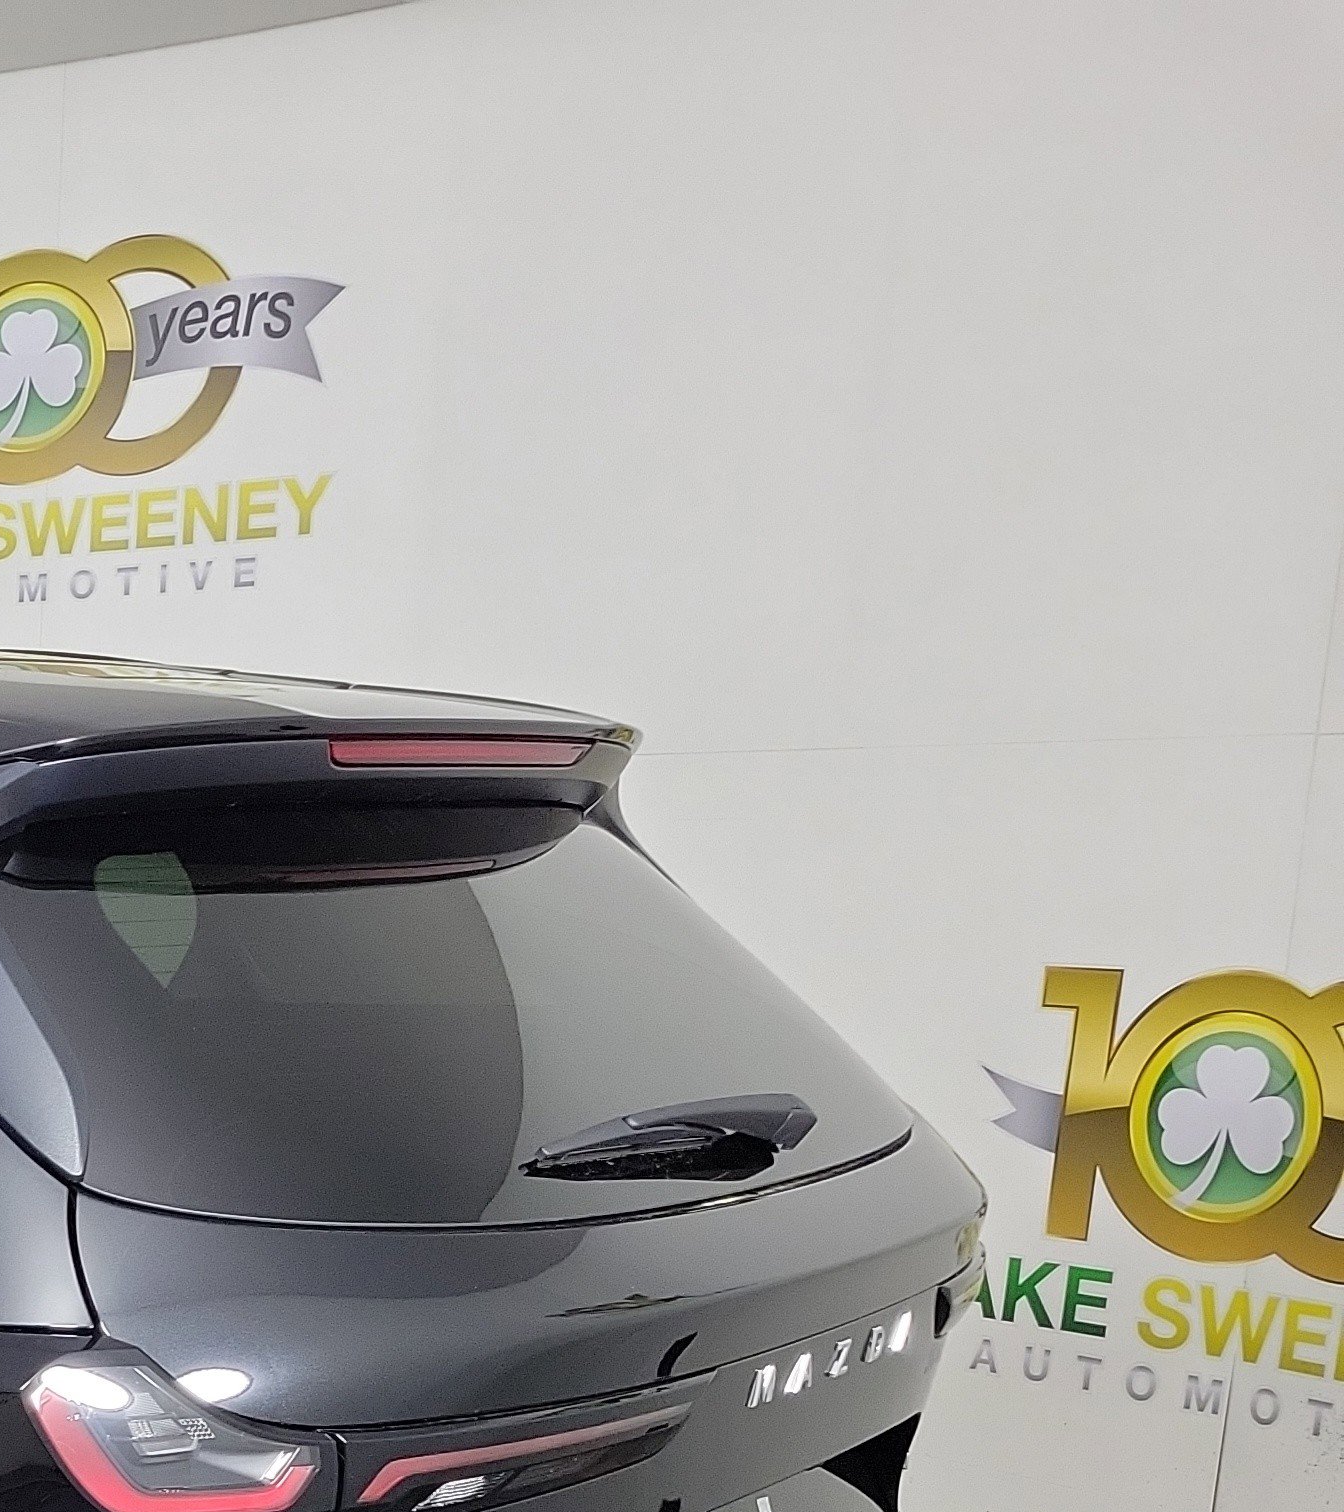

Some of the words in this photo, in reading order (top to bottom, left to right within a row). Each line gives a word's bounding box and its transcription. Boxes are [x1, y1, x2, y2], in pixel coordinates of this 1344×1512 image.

[145, 289, 295, 367] years
[745, 1311, 912, 1408] MAZDA
[972, 1257, 1115, 1339] AKE
[1137, 1276, 1344, 1383] SWE
